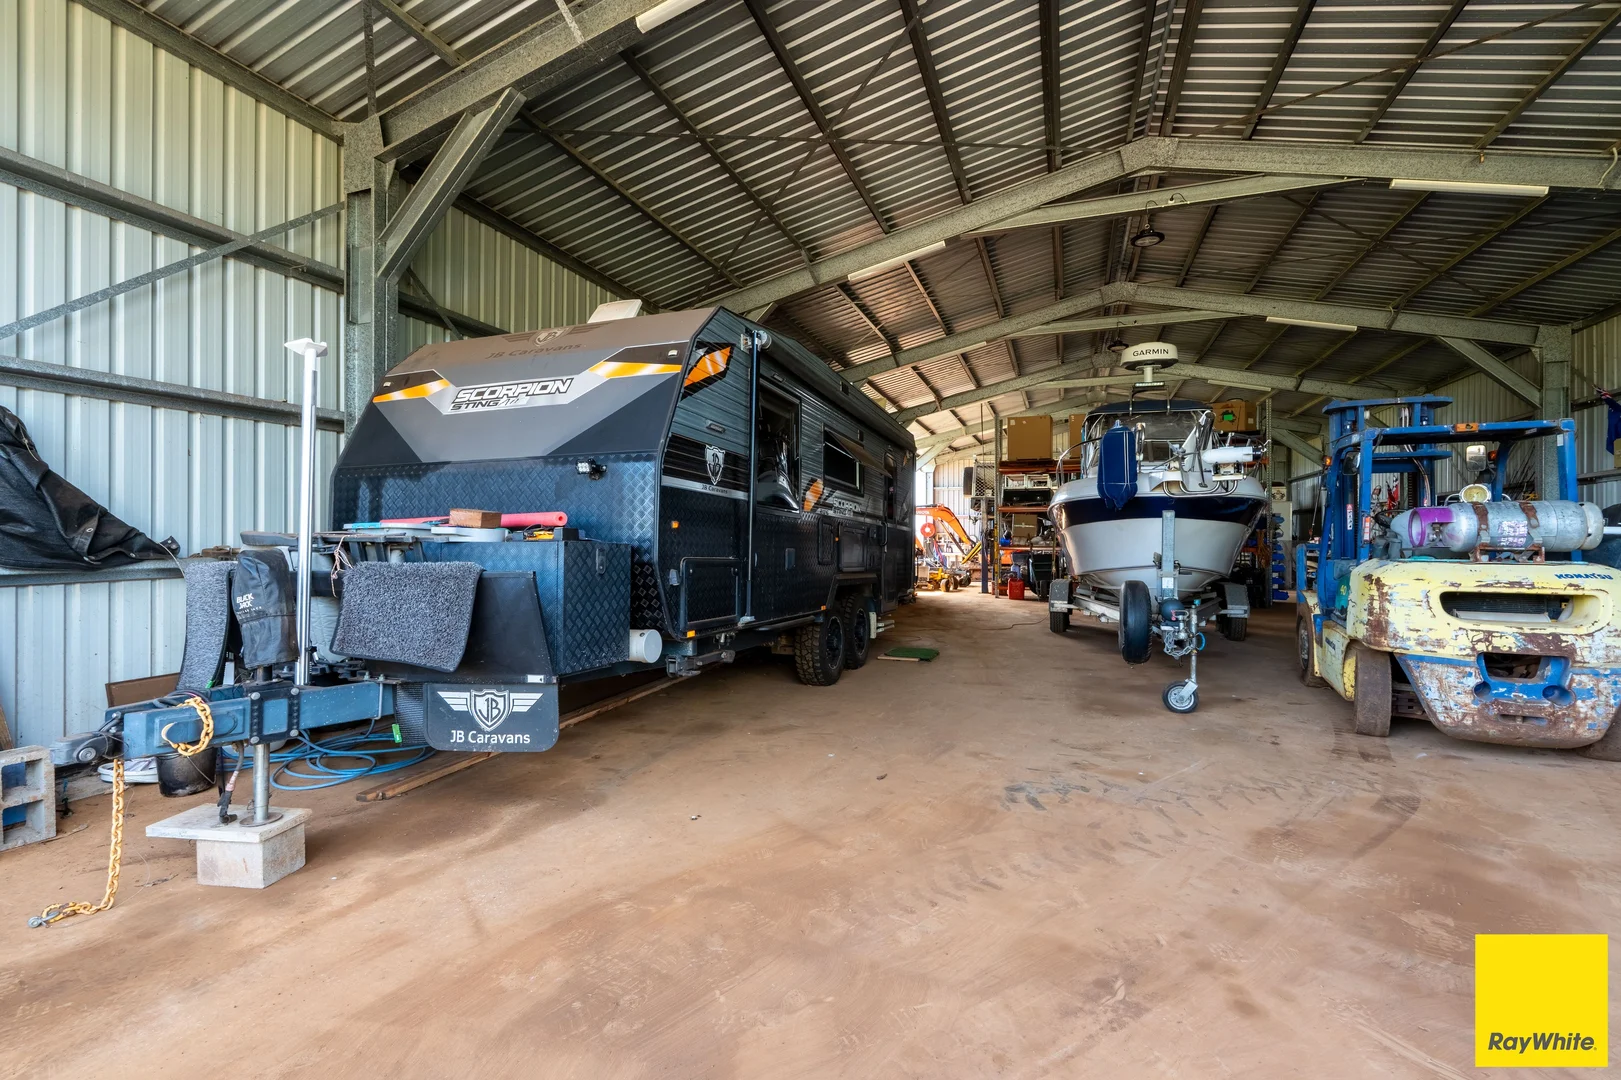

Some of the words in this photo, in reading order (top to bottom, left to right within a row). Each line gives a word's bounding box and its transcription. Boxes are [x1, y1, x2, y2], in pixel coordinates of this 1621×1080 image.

[486, 351, 504, 359] JB
[508, 343, 582, 357] Caravans
[1132, 348, 1169, 357] GARMIN
[451, 377, 575, 404] SCORPION
[450, 730, 465, 743] JB
[468, 730, 531, 744] Caravans
